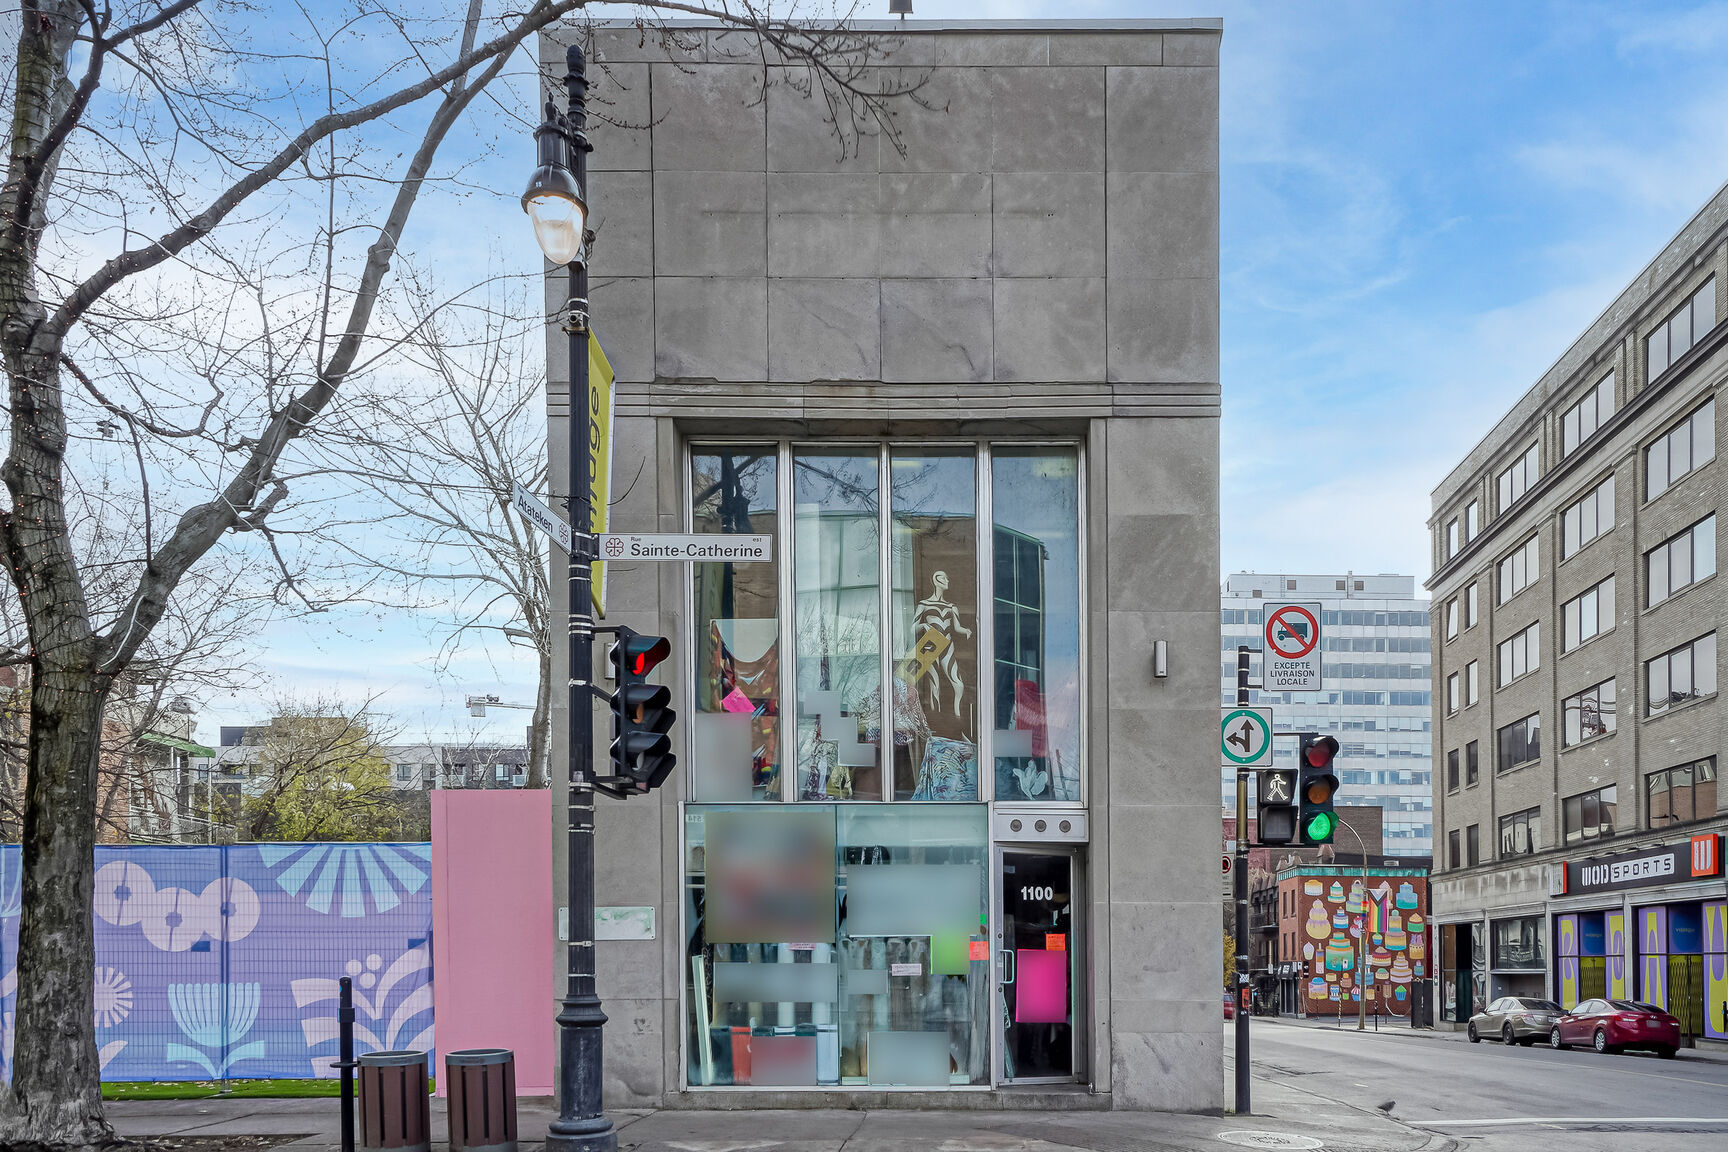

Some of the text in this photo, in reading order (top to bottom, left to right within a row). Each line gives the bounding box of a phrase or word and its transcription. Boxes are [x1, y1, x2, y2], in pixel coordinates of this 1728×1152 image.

[518, 494, 553, 533] Atateken
[630, 543, 763, 558] Sainte-Catherine
[1612, 858, 1672, 879] SPORTS
[1020, 886, 1054, 901] 1100
